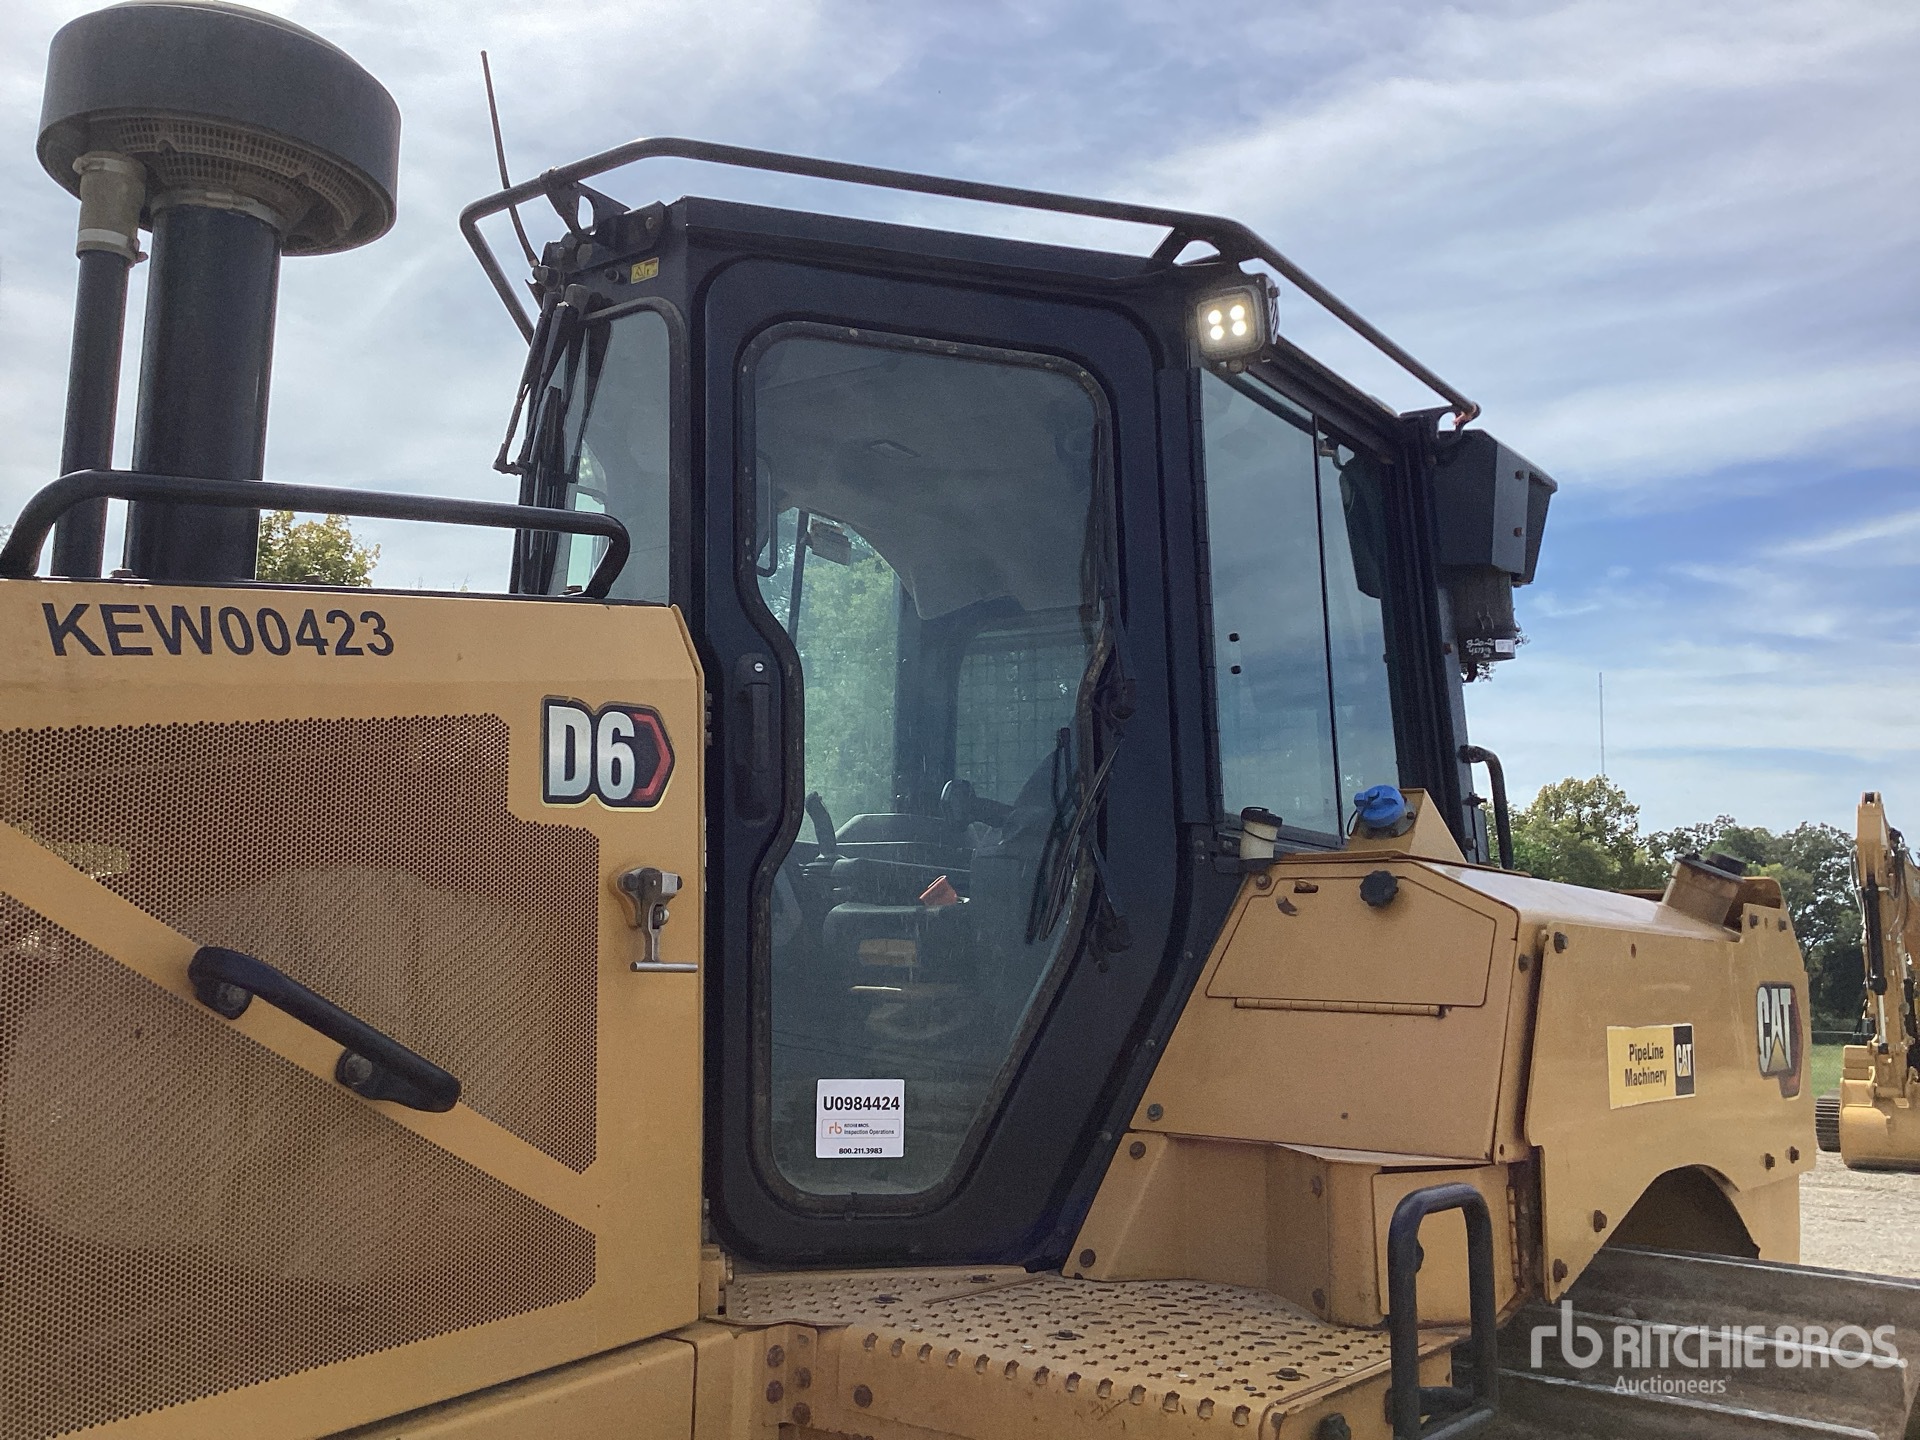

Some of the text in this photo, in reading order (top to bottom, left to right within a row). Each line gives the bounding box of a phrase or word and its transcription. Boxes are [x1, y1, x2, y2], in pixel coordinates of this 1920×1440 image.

[43, 602, 395, 658] KEW00423
[547, 705, 637, 799] D6
[1757, 986, 1792, 1073] CAT
[1628, 1043, 1664, 1065] PipeLine
[1675, 1043, 1692, 1077] CAT
[1624, 1068, 1667, 1087] Machinery
[823, 1096, 900, 1111] U0984424
[839, 1147, 883, 1155] 800.211.3983
